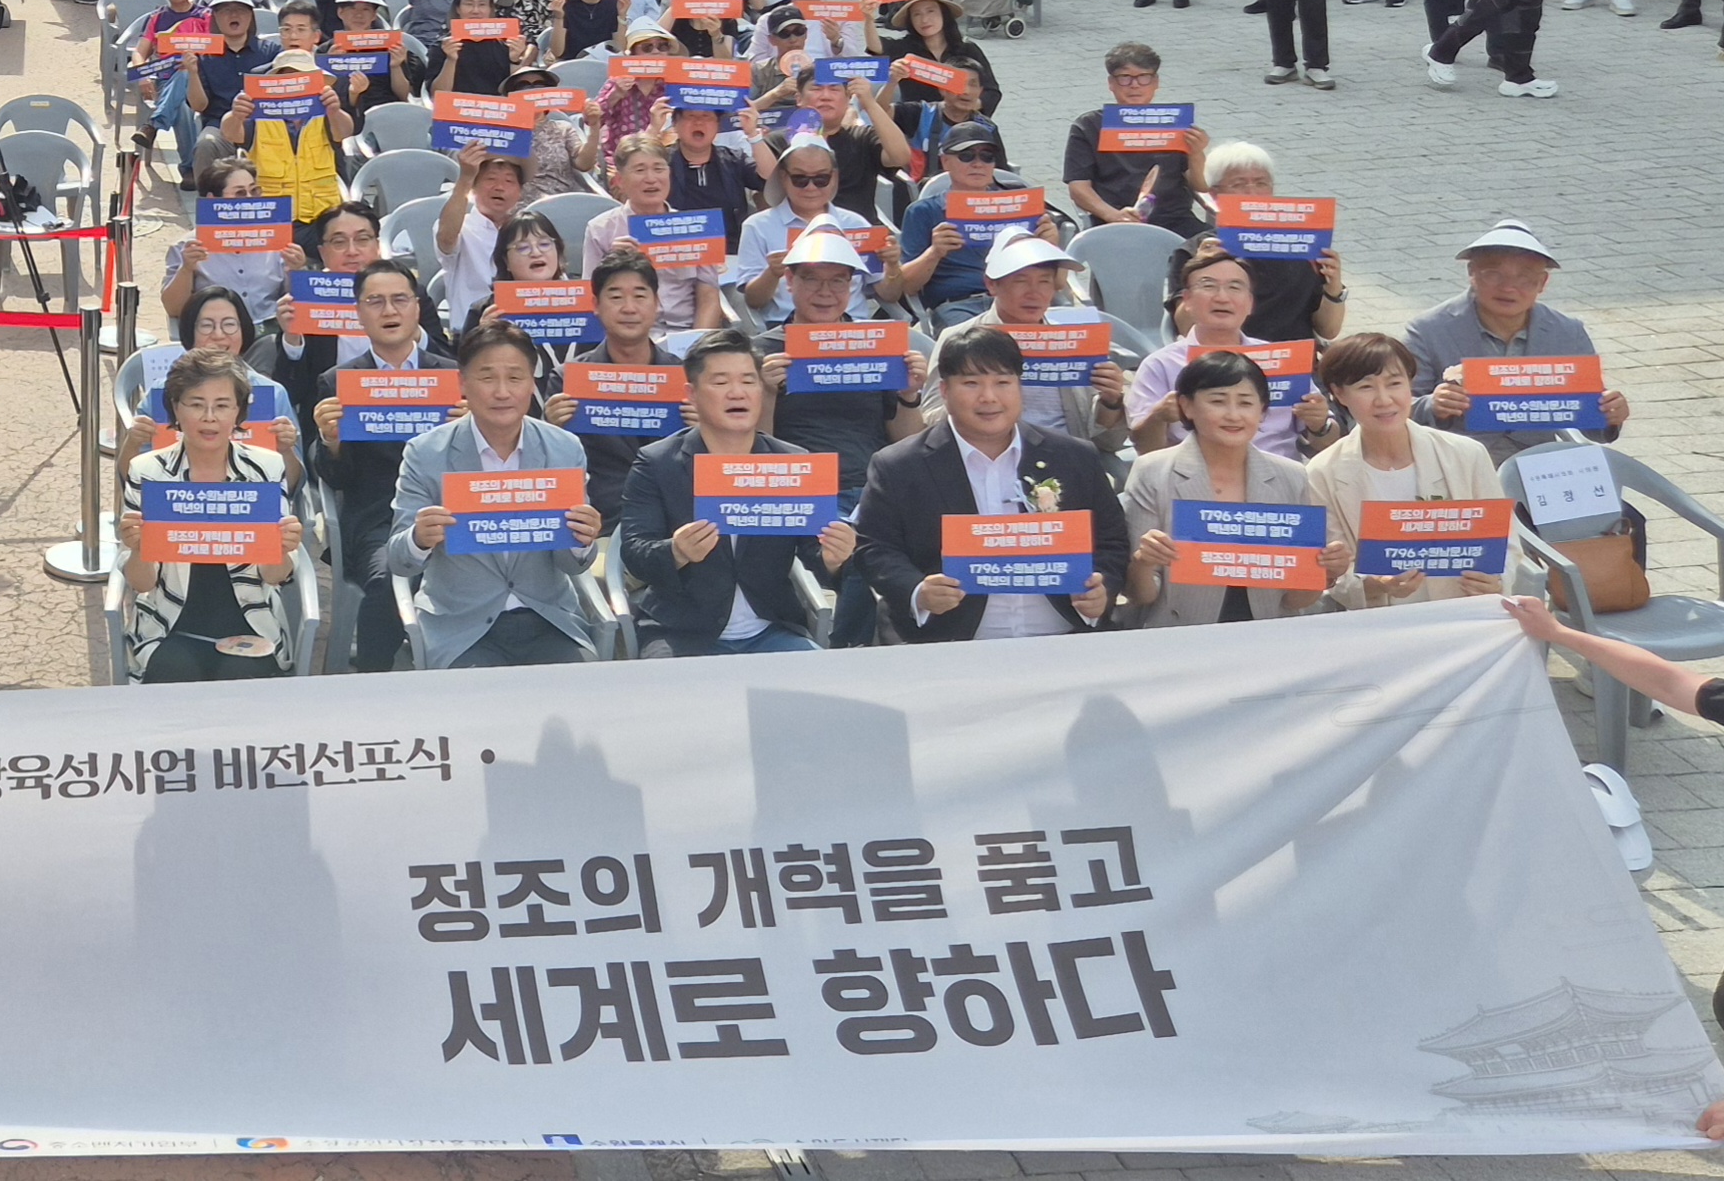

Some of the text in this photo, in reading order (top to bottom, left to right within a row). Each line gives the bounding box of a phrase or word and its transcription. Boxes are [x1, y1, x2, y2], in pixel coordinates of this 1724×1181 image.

[165, 490, 195, 501] 1796
[719, 503, 750, 513] 1796
[1199, 510, 1232, 521] 1796
[468, 520, 498, 531] 1796
[213, 736, 452, 791] 비전선포식
[409, 825, 1154, 942] 정조의 개혁을 품고
[441, 930, 1178, 1065] 세계로 향하다
